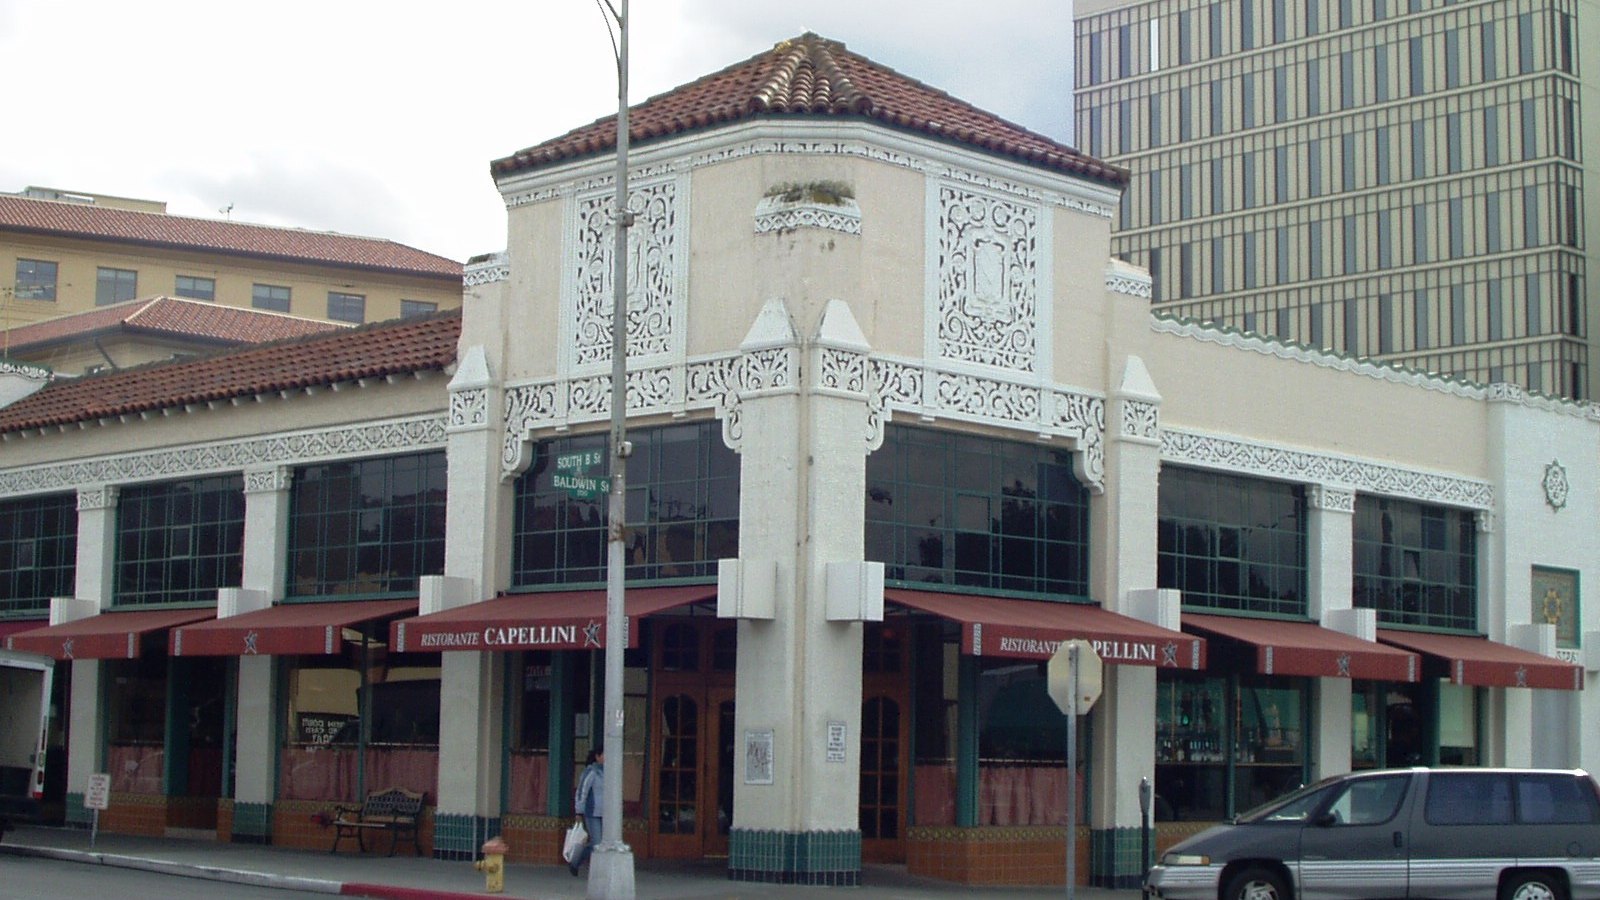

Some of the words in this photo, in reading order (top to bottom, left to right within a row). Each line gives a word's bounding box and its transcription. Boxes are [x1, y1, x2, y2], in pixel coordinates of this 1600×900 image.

[557, 454, 582, 469] SOUTH
[585, 453, 591, 465] B
[553, 475, 597, 491] BALDWIN
[420, 632, 479, 647] RISTORANTE
[484, 625, 577, 645] CAPELLINI
[1093, 640, 1156, 661] PELLINI
